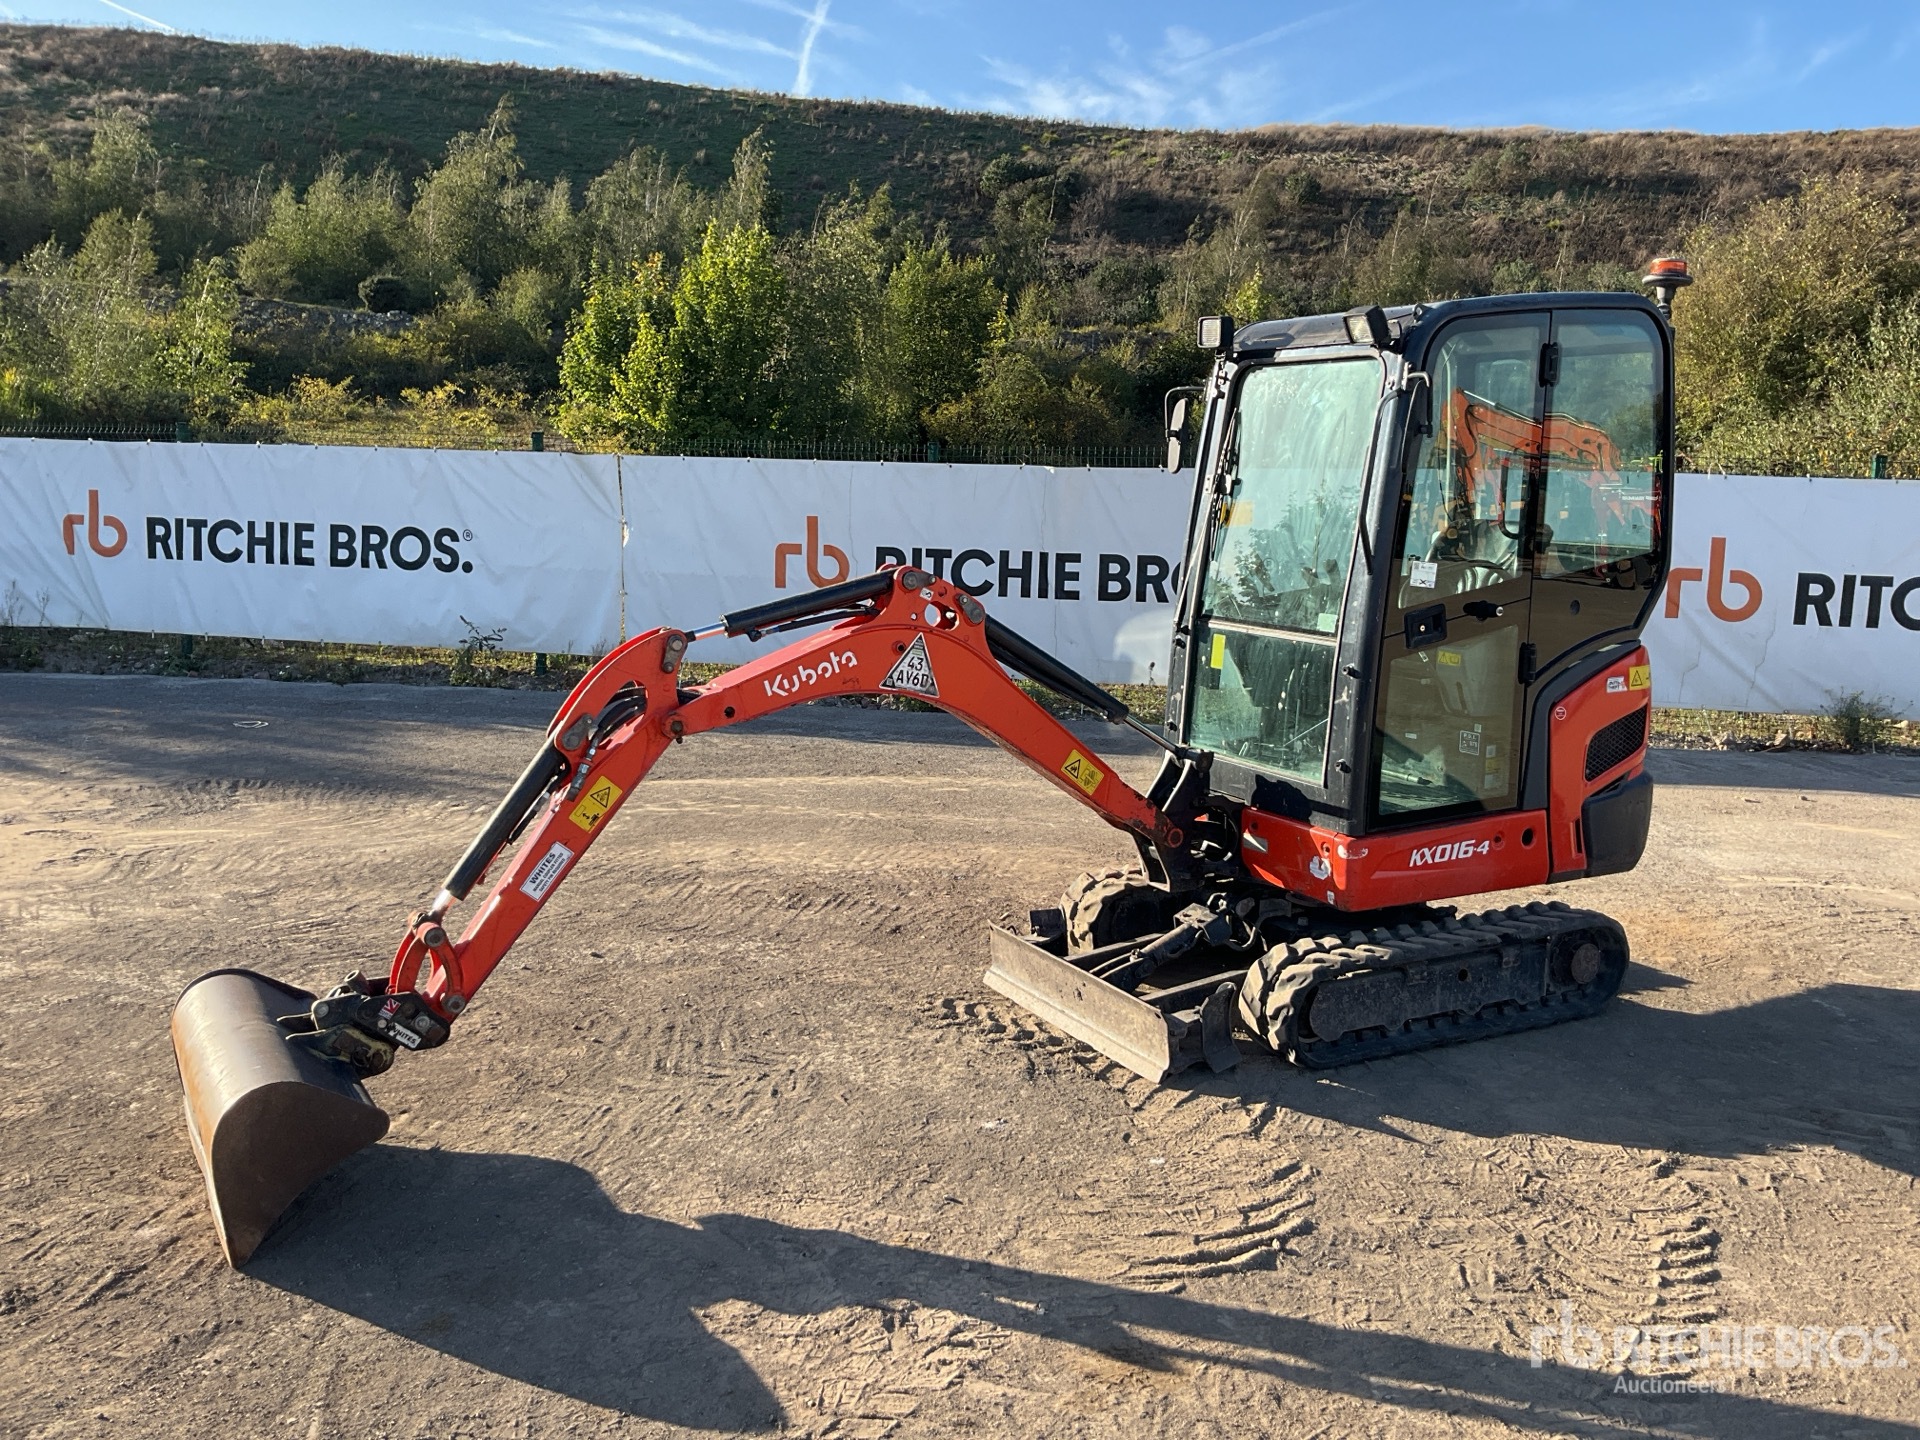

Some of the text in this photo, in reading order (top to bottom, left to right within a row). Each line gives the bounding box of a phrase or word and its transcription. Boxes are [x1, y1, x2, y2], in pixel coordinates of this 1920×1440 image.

[146, 516, 315, 567] RITCHIE
[1097, 553, 1182, 603] BR
[763, 650, 858, 697] Kubota
[907, 656, 924, 671] 43
[529, 852, 556, 884] WHITES
